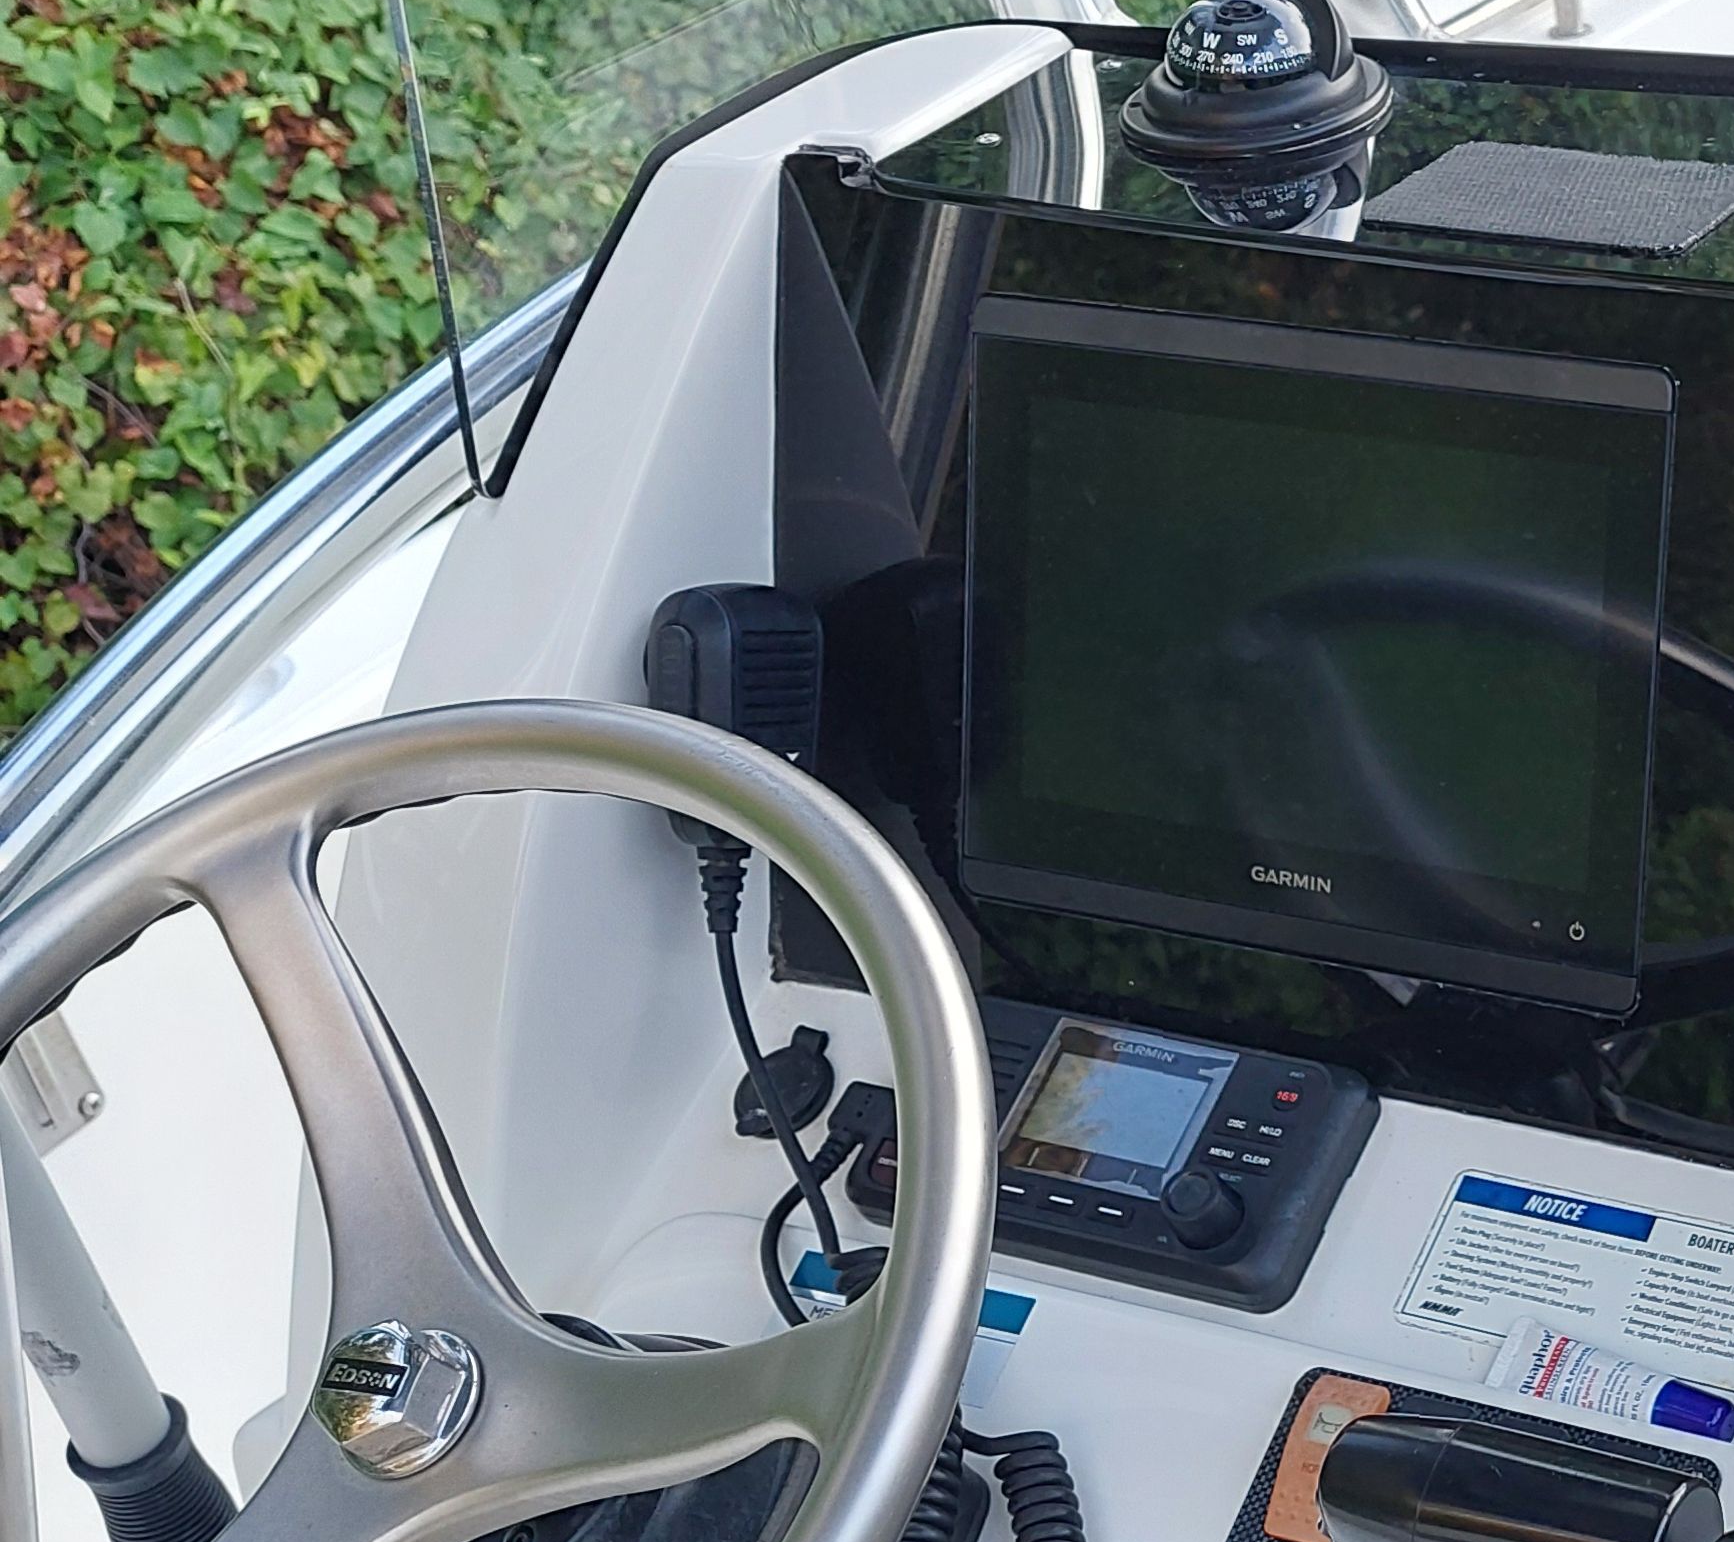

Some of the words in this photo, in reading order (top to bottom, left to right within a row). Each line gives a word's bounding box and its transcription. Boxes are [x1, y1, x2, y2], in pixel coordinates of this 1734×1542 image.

[1203, 32, 1221, 49] W
[1237, 34, 1257, 46] SW
[1274, 28, 1288, 45] S
[1197, 50, 1215, 63] 270
[1222, 53, 1243, 65] 240
[1253, 51, 1273, 63] 210
[1251, 865, 1332, 894] GARMIN
[1112, 1041, 1175, 1063] GARMIN
[1208, 1147, 1235, 1159] MENU
[1242, 1154, 1271, 1166] CLEAR
[1523, 1194, 1588, 1222] NOTICE
[1518, 1329, 1555, 1395] quaphor
[326, 1363, 400, 1390] EDSON
